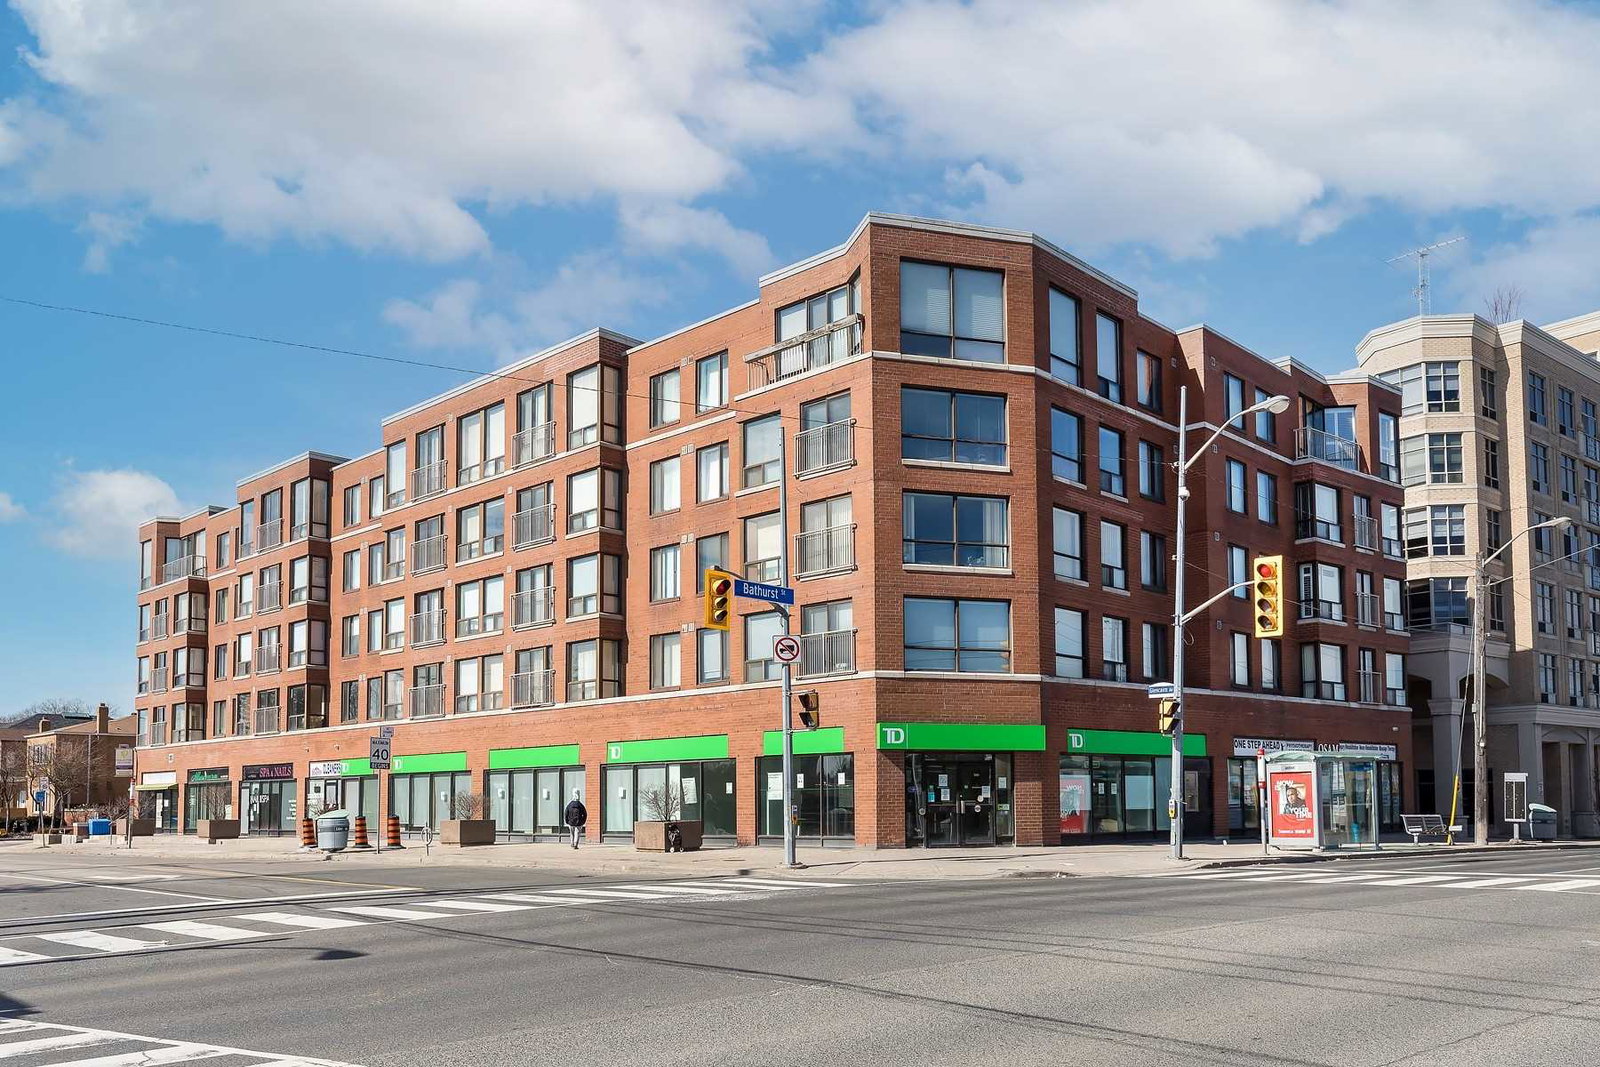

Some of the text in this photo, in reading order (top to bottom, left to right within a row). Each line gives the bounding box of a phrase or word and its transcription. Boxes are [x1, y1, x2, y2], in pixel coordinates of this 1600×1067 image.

[743, 582, 786, 600] Bathurst St
[882, 727, 905, 744] TD
[1068, 733, 1084, 748] TD
[1234, 739, 1280, 750] ONE STEP AHEAD
[371, 748, 389, 761] 40
[260, 767, 270, 778] SPA
[274, 766, 292, 777] NAILS
[1289, 806, 1310, 814] YOUR
